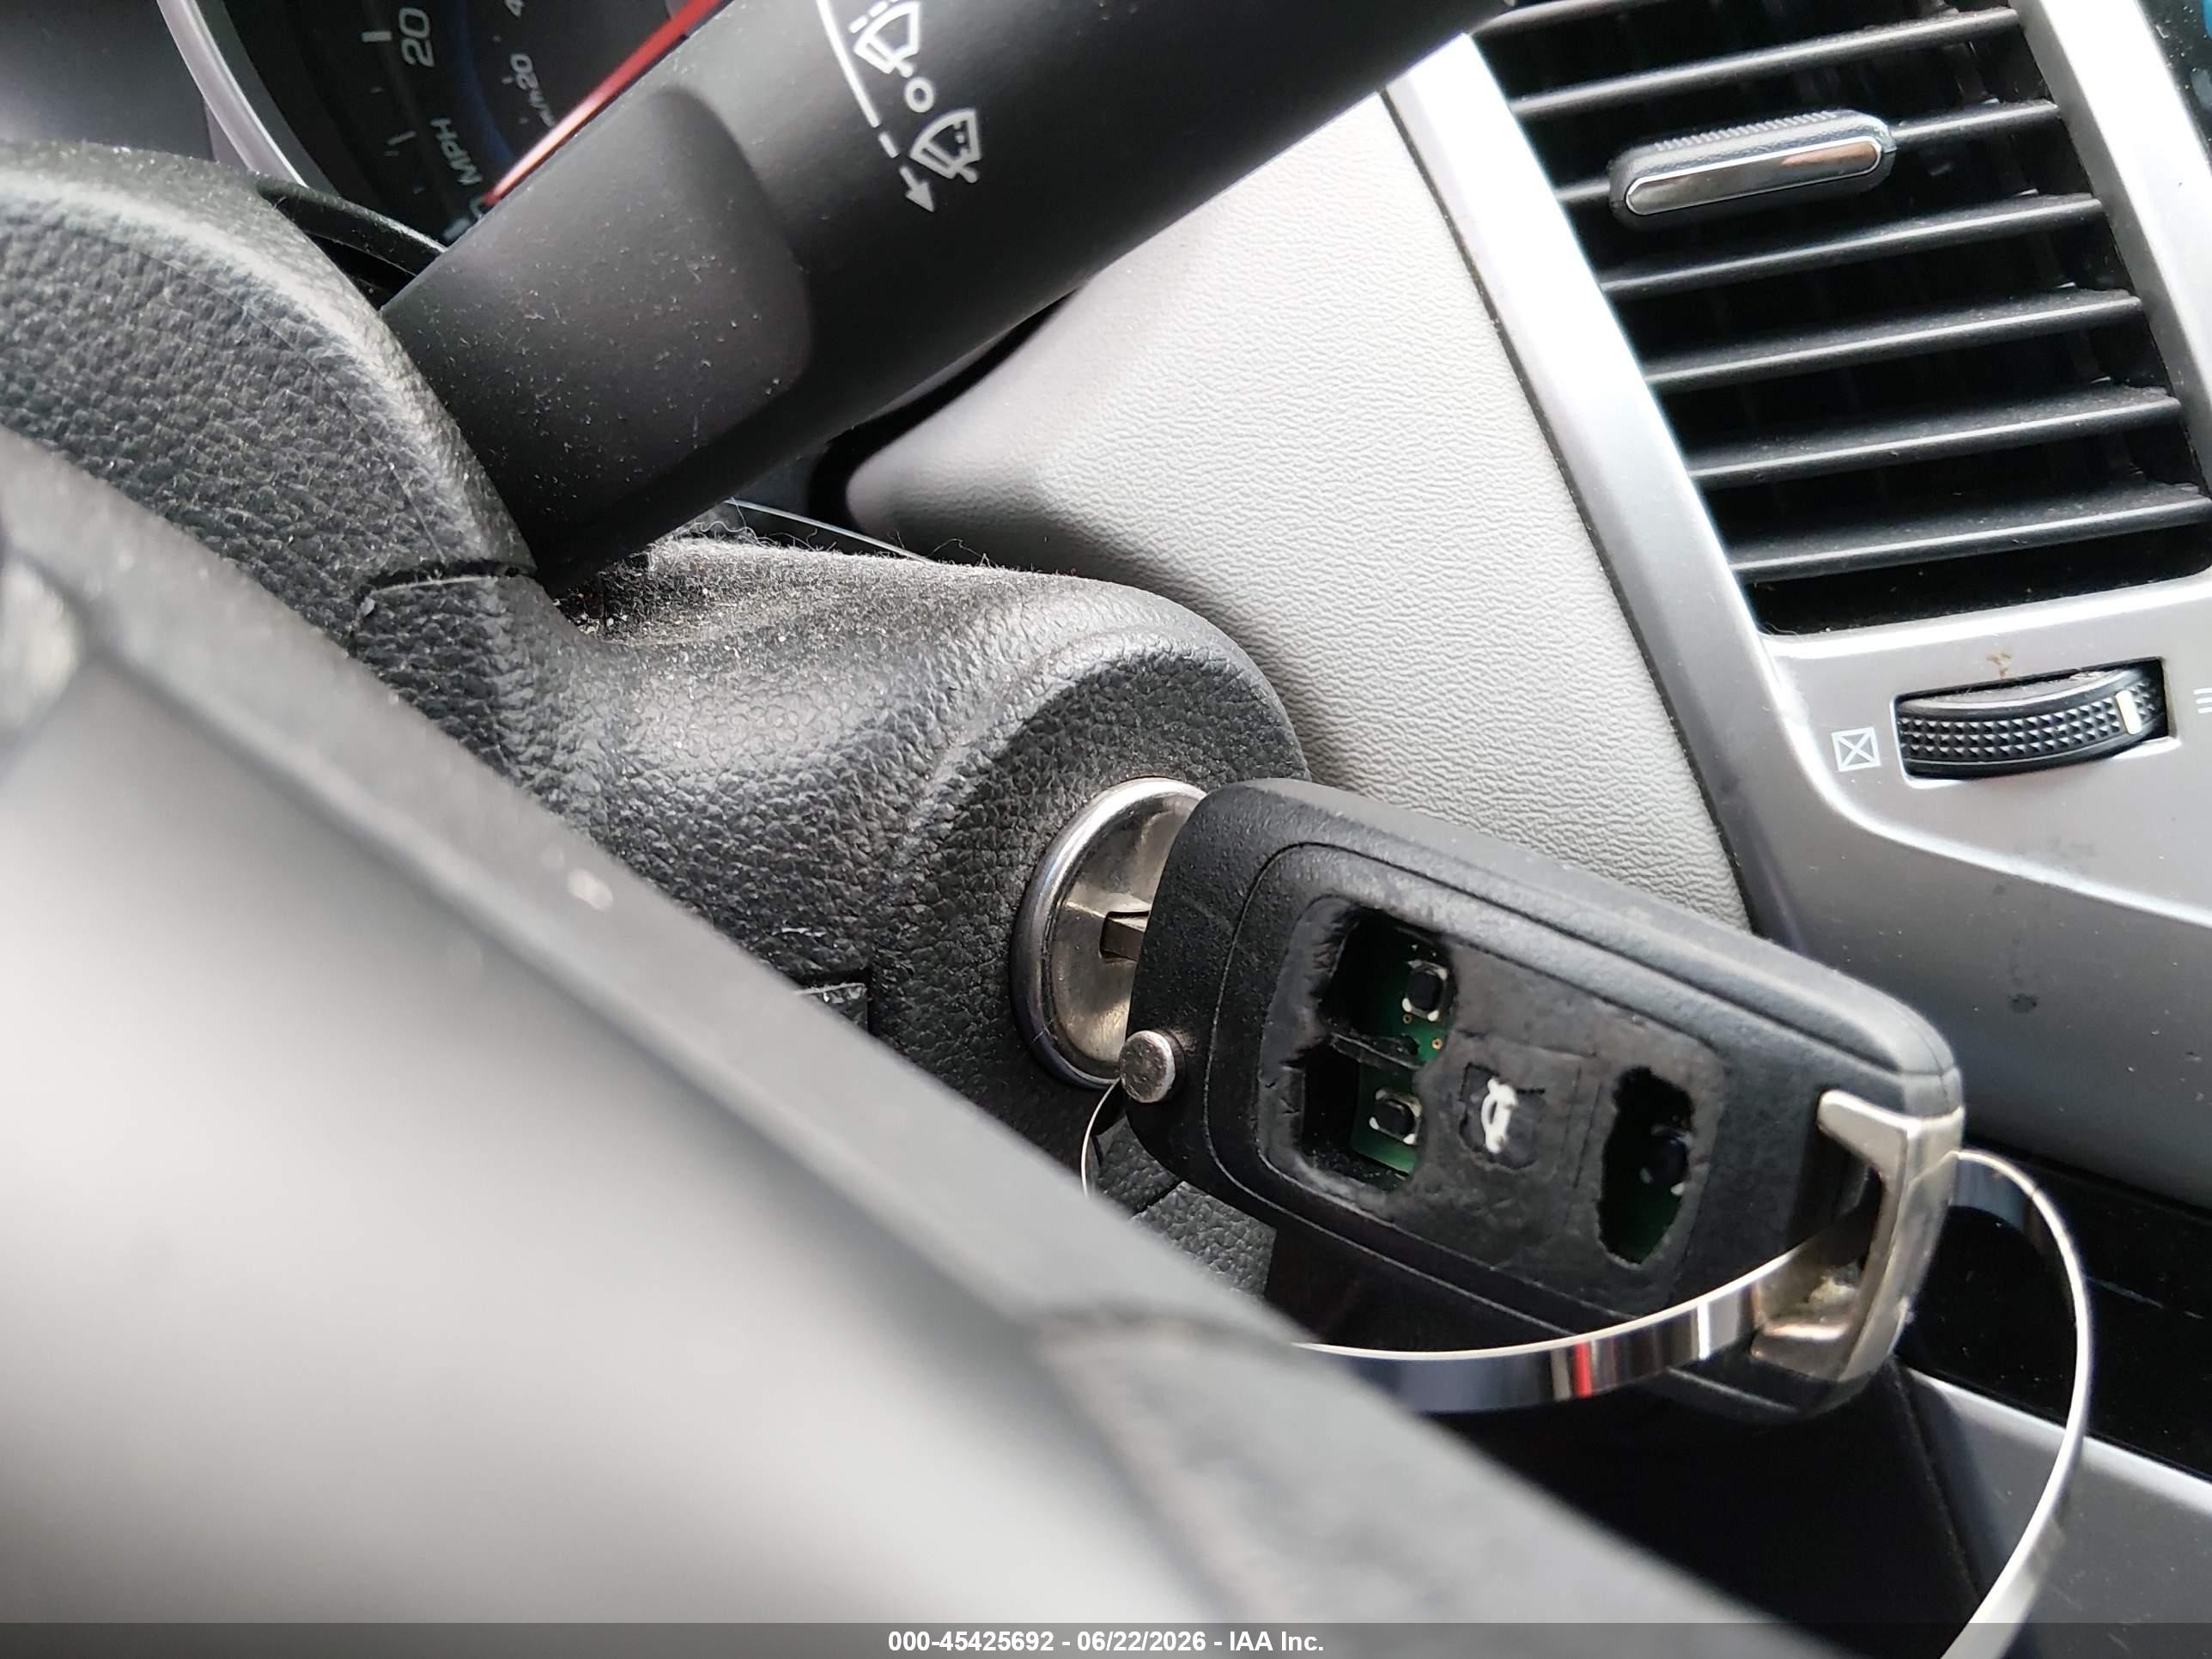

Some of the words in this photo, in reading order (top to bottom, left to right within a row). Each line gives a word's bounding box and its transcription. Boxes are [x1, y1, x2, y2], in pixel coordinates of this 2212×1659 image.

[398, 7, 434, 67] 20
[510, 53, 538, 90] 20
[430, 117, 483, 185] MPH
